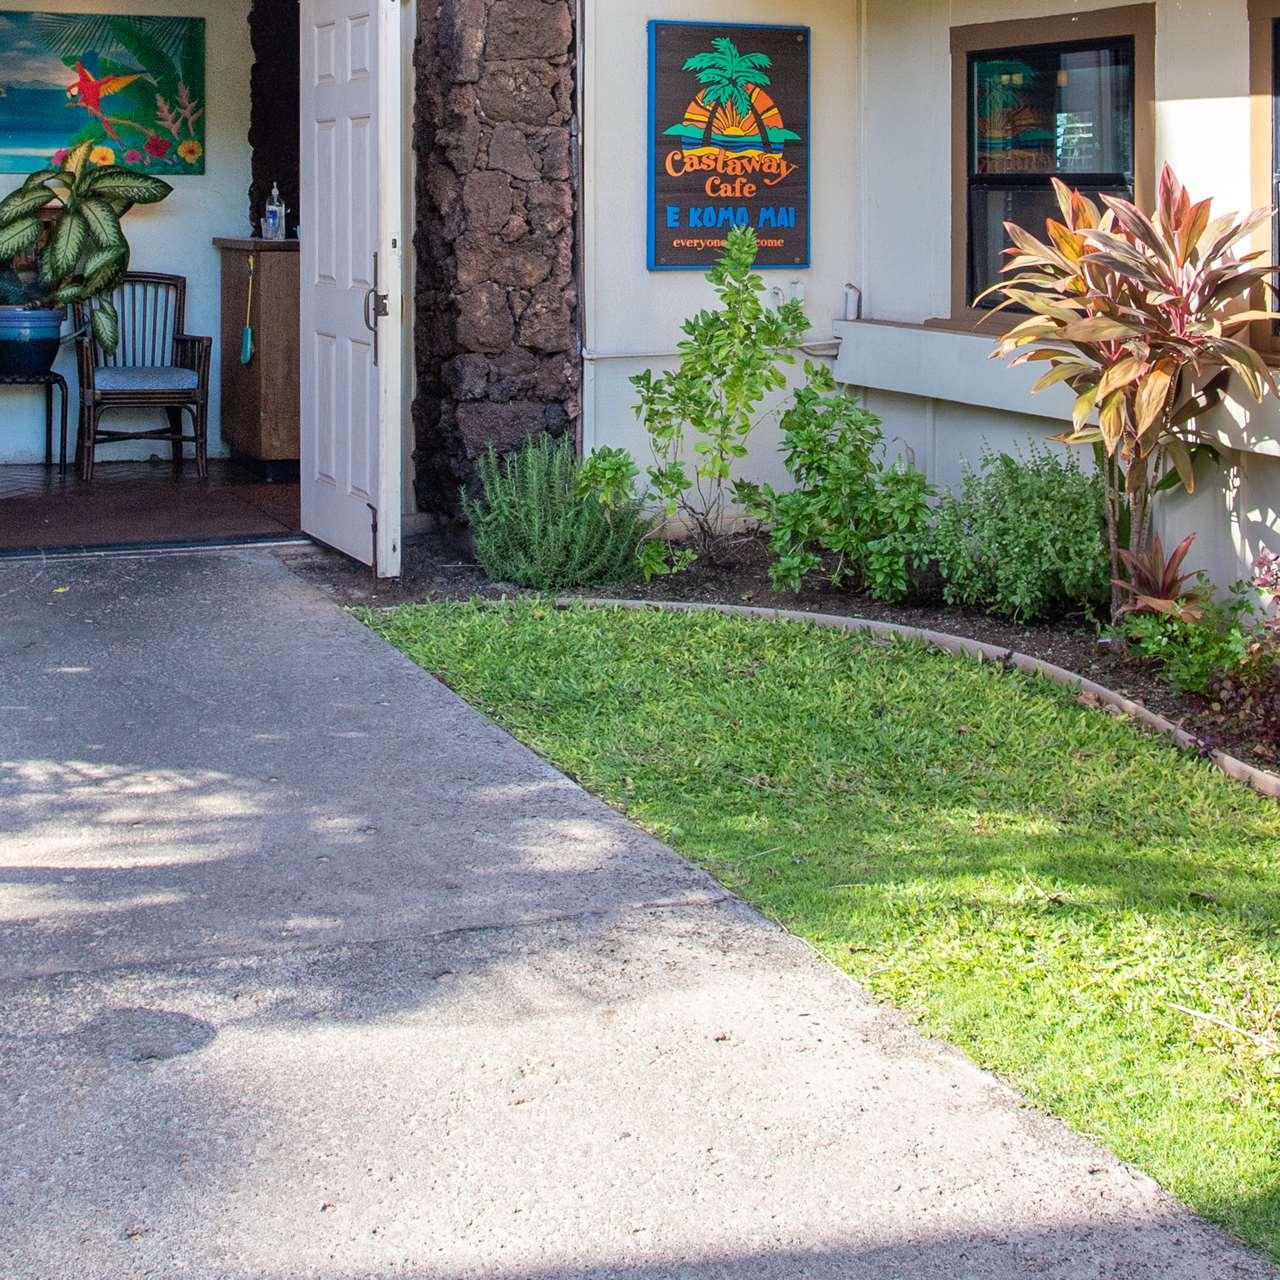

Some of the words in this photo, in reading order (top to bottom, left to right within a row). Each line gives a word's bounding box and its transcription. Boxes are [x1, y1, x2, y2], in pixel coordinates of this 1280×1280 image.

[665, 150, 799, 186] Castaway
[705, 177, 757, 198] Cafe
[666, 206, 680, 228] E
[688, 207, 749, 228] KOMO
[758, 207, 796, 228] MAI
